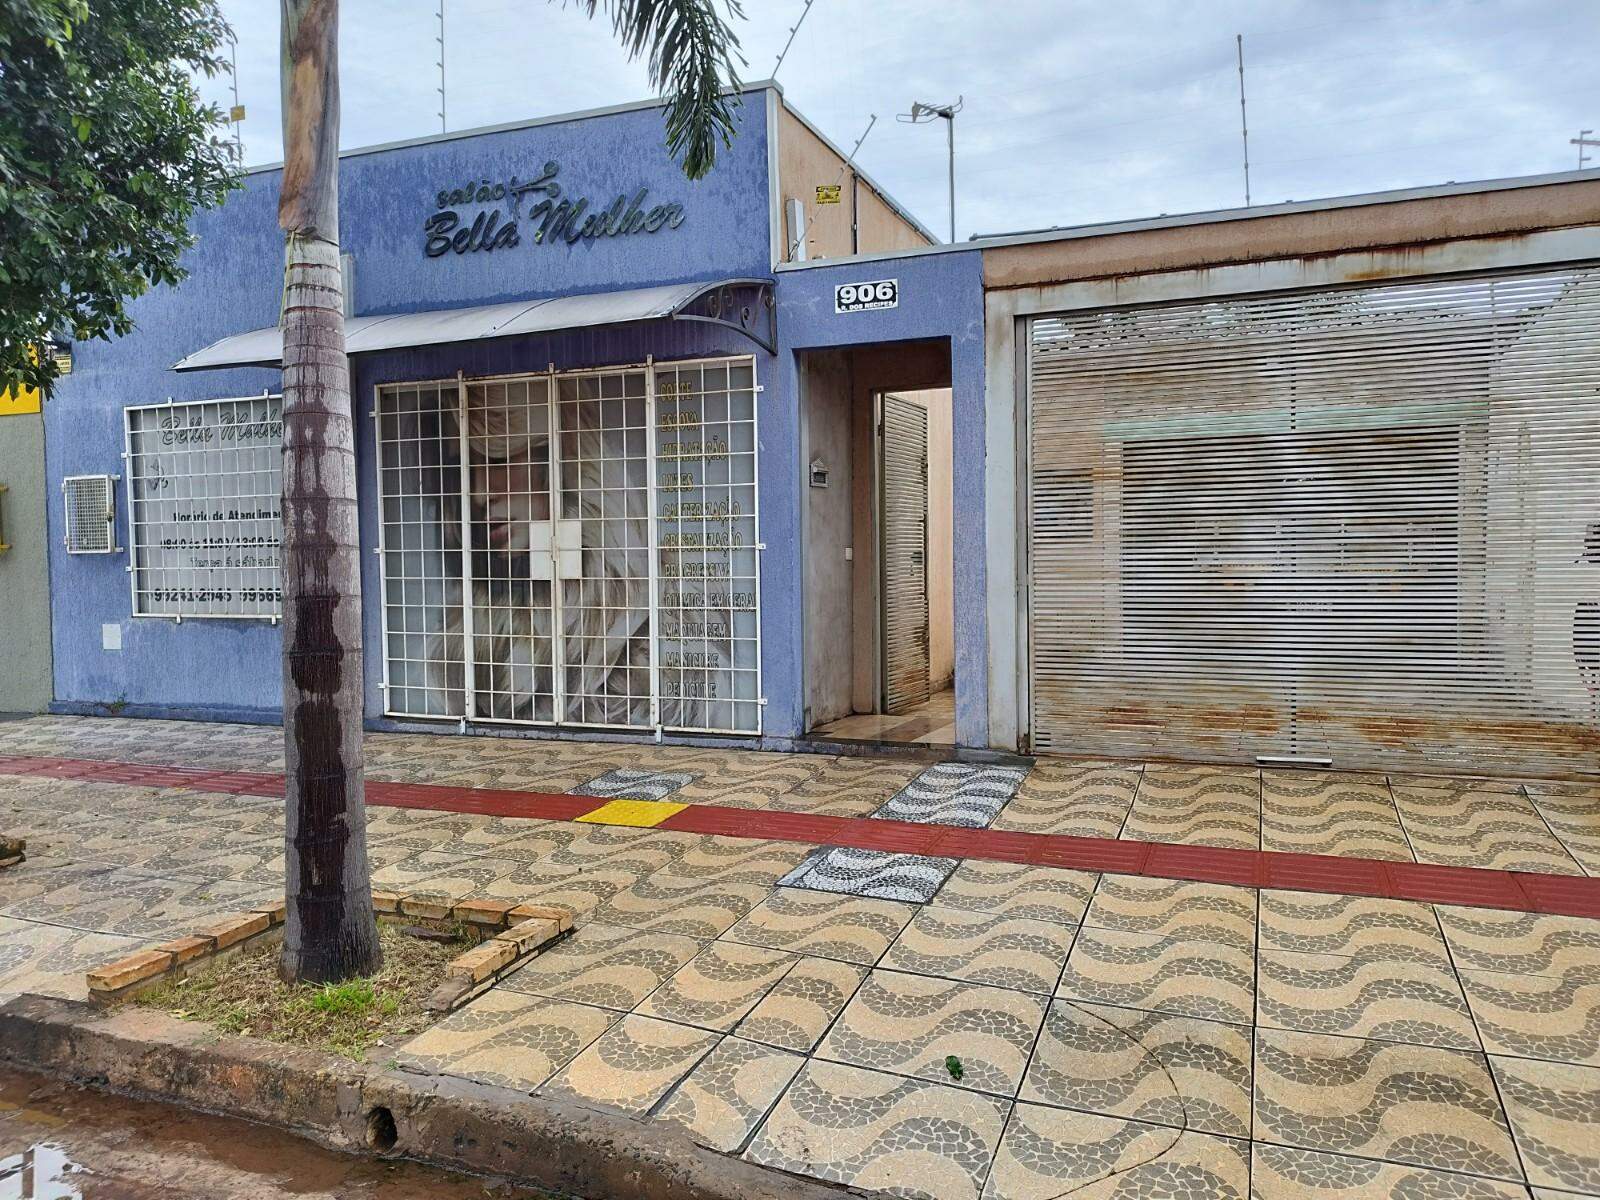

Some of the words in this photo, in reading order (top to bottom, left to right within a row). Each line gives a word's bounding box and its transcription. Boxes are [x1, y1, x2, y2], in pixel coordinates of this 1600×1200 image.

[437, 180, 505, 209] salão
[424, 210, 519, 257] Bella
[529, 187, 685, 244] Mulher
[840, 283, 893, 303] 906
[161, 416, 213, 446] Bella
[661, 411, 700, 433] ESCOVA
[662, 473, 693, 492] LUZES
[213, 510, 223, 521] de
[666, 652, 720, 672] MANICURE
